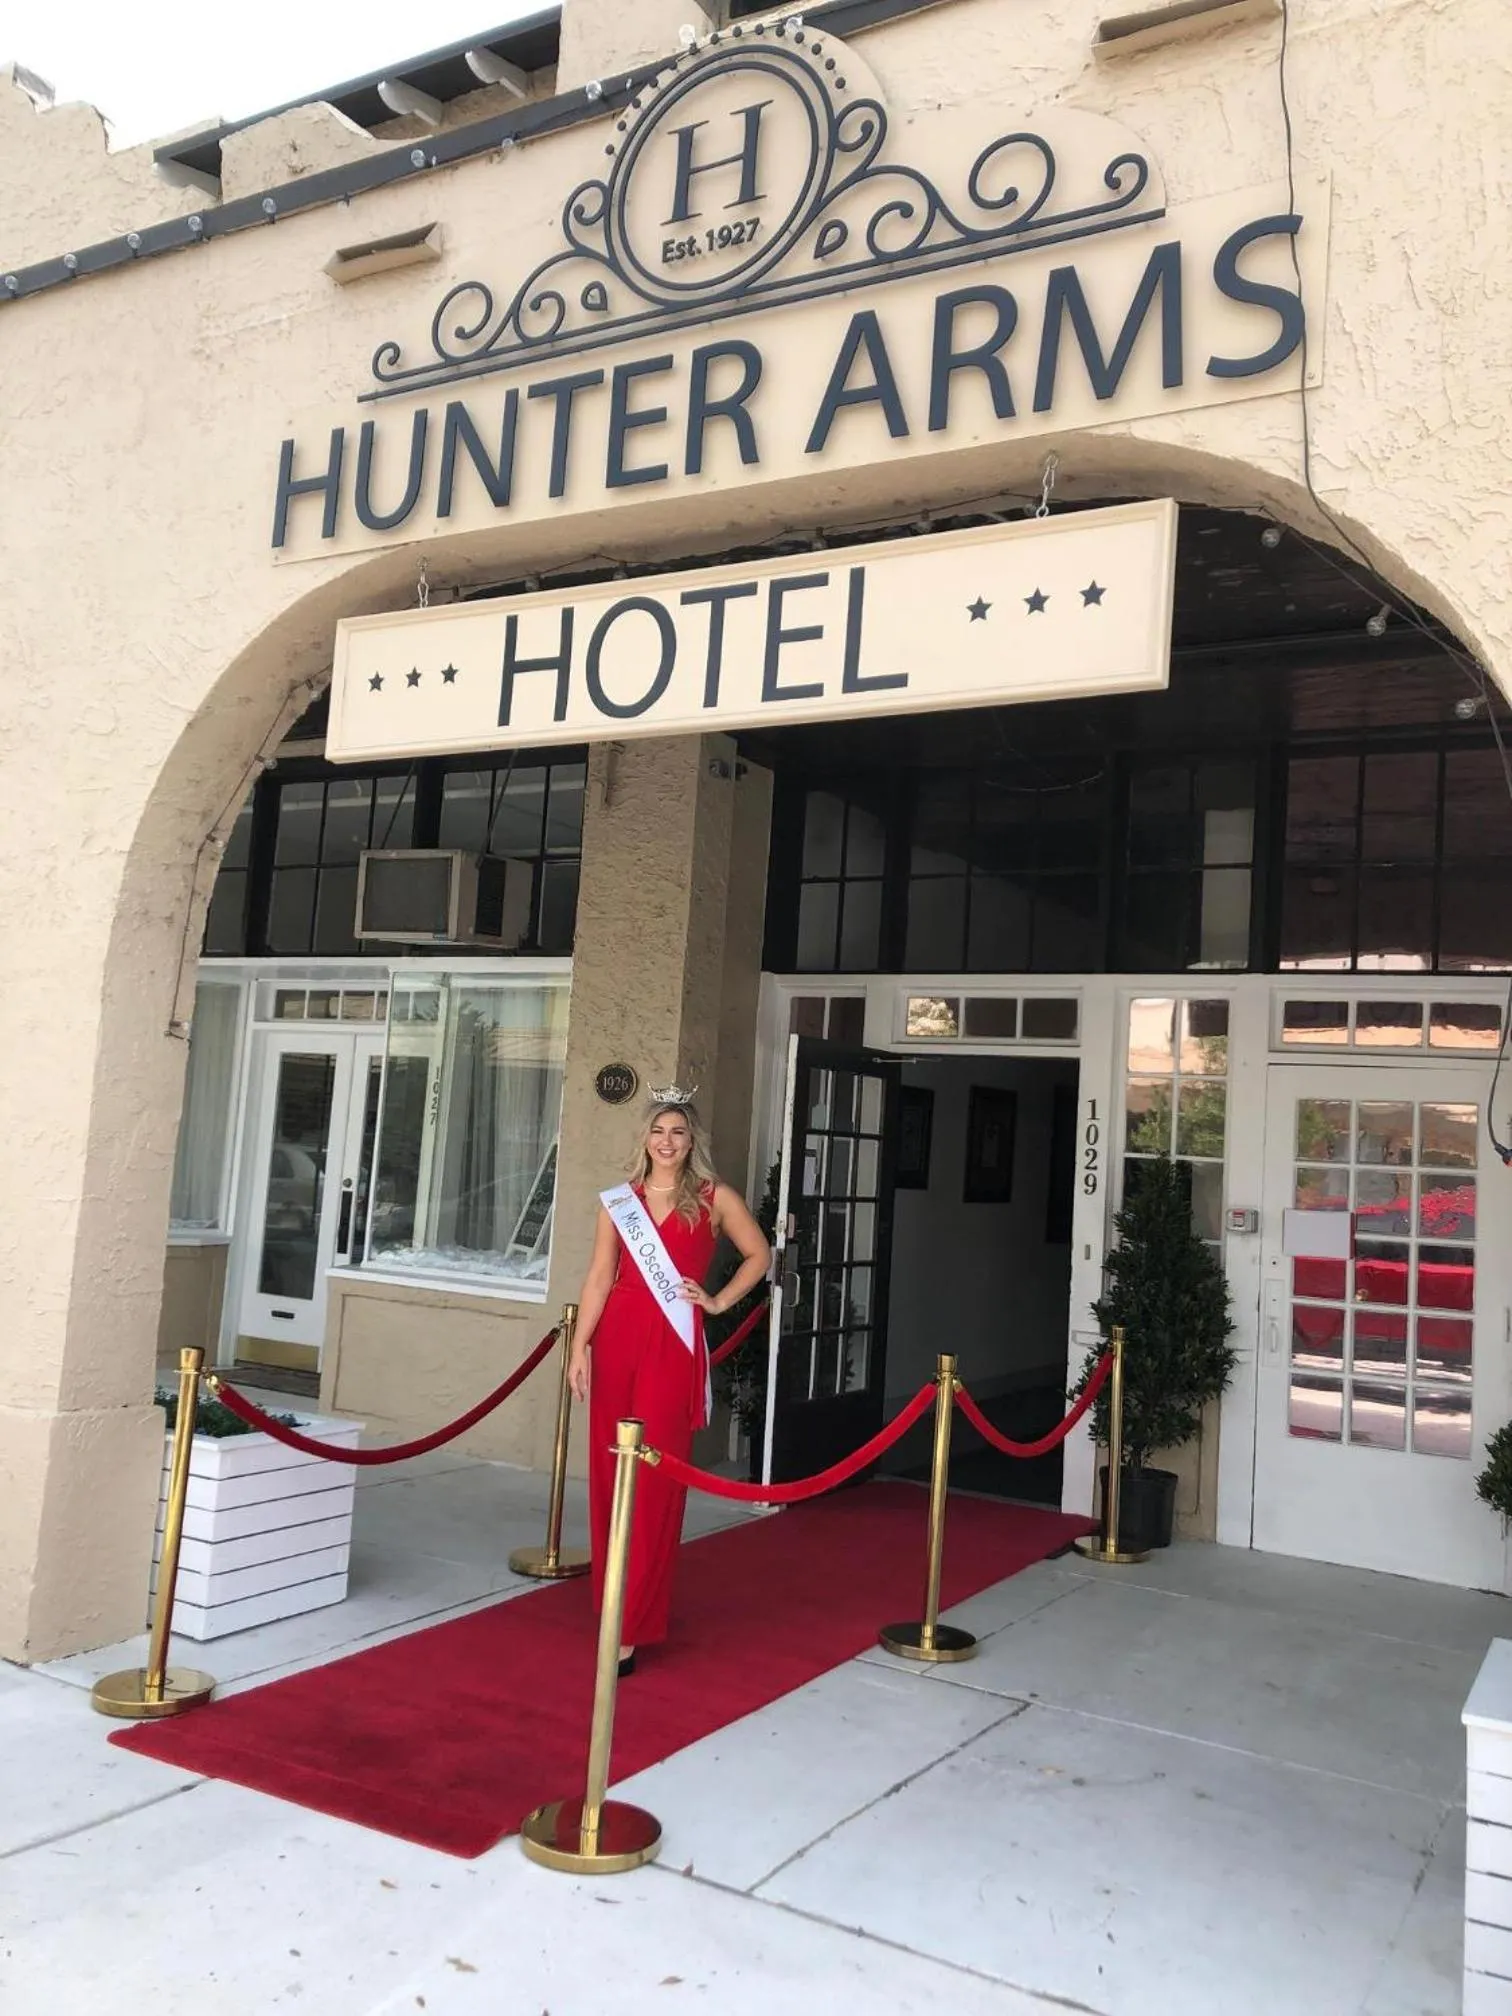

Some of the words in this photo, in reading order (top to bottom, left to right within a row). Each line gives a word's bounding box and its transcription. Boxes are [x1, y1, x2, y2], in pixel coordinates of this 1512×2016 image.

[661, 100, 774, 226] H
[705, 217, 760, 251] 1927
[271, 339, 763, 548] HUNTER
[804, 214, 1306, 453] ARMS
[497, 567, 908, 727] HOTEL
[603, 1075, 629, 1091] 1926
[1083, 1098, 1101, 1195] 1029
[622, 1210, 644, 1241] Miss
[639, 1242, 680, 1304] Osceola
